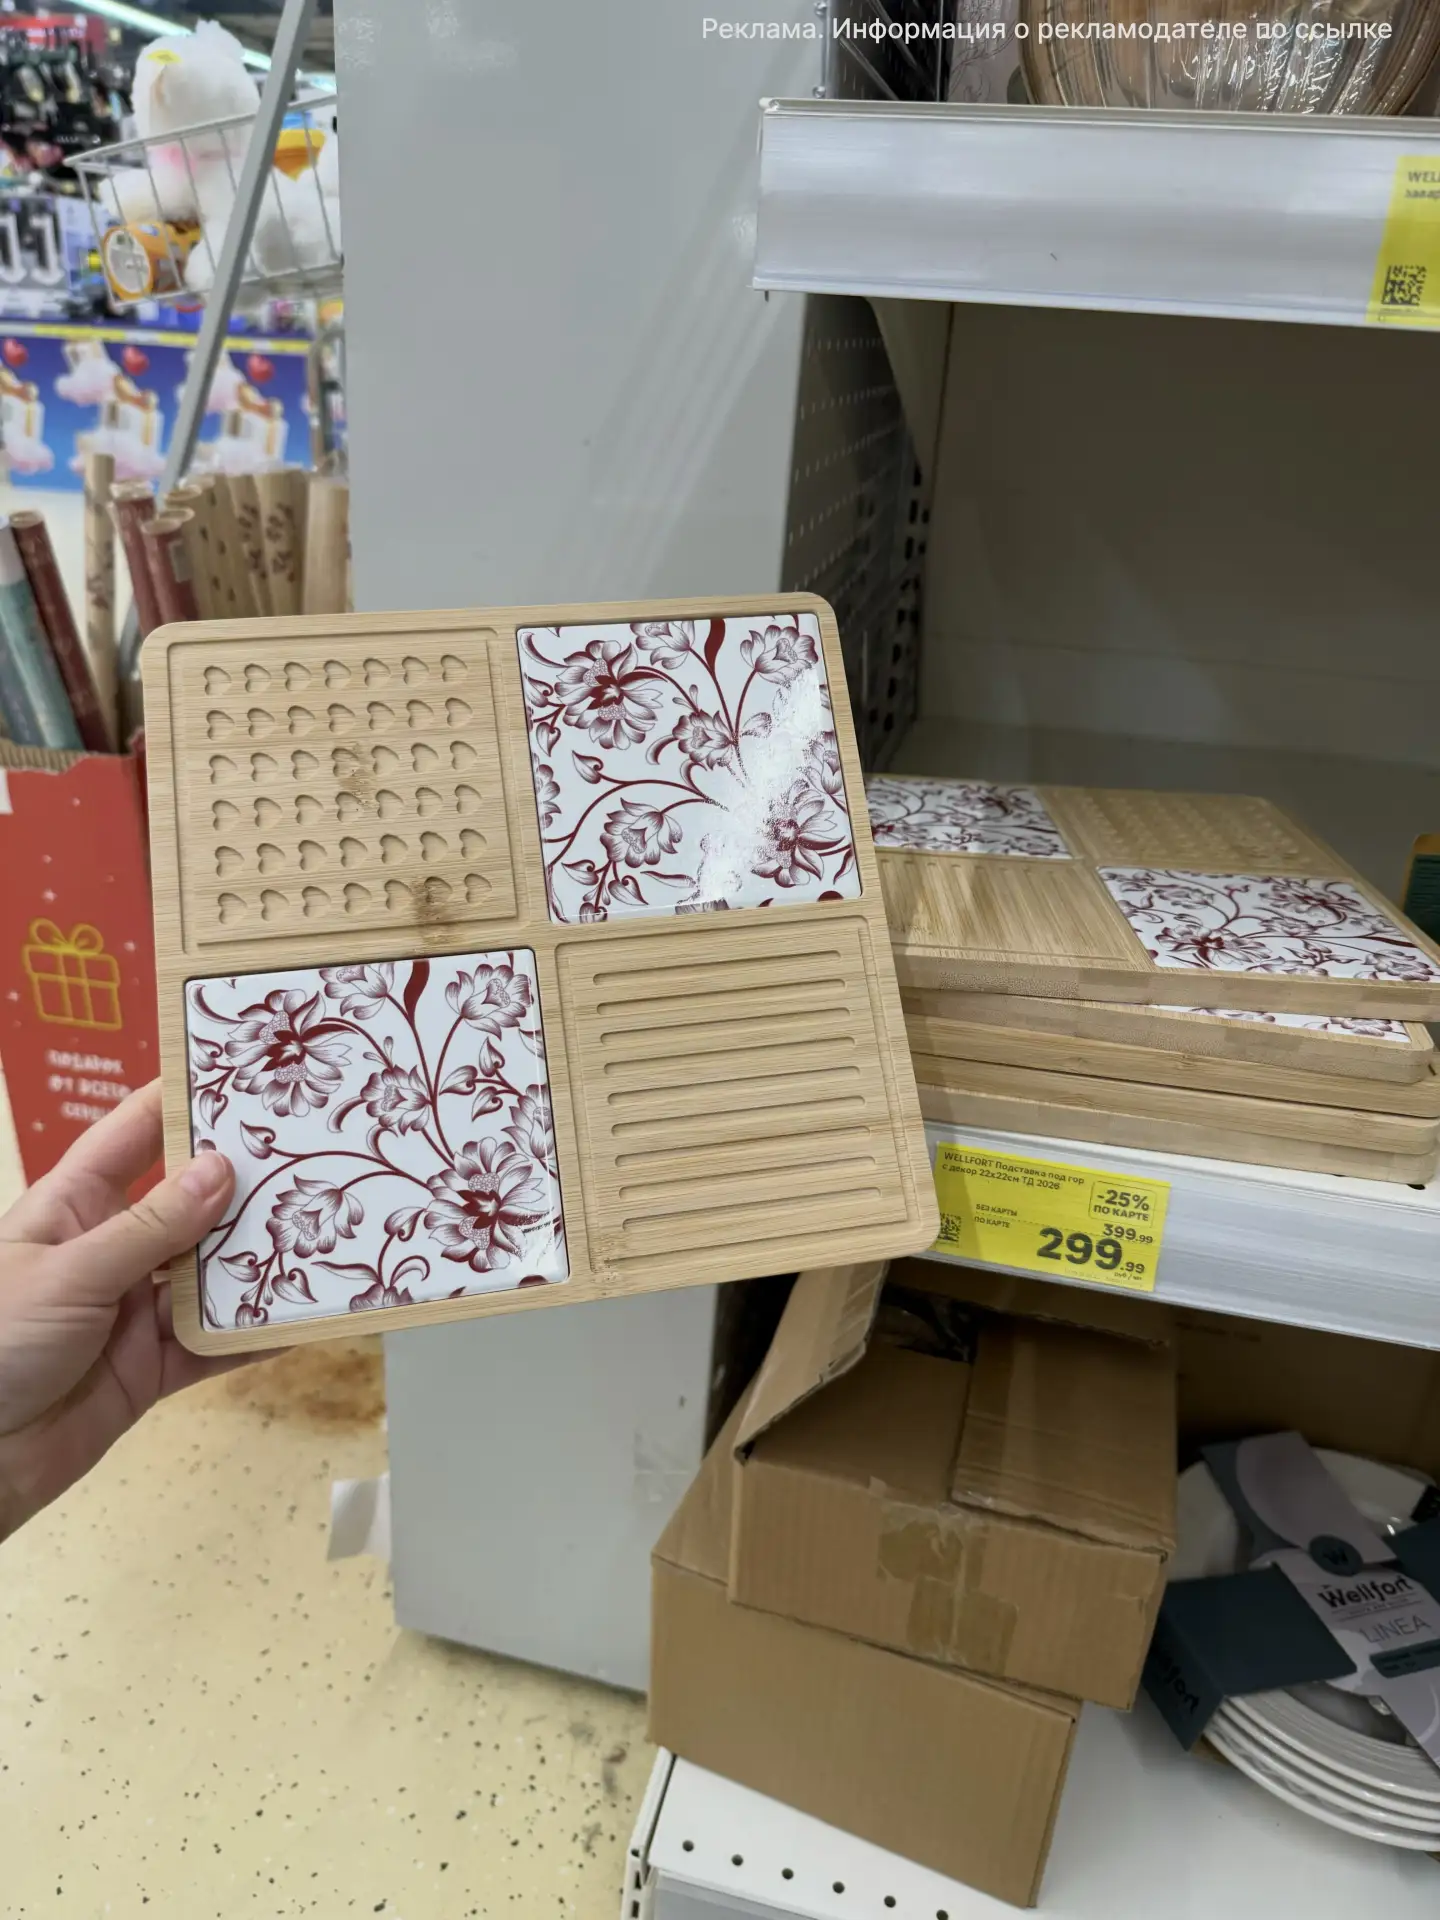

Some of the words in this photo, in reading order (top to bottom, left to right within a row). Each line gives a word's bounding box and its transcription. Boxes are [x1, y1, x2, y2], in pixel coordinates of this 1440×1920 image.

[943, 1151, 994, 1167] WELLFORT
[995, 1161, 1046, 1178] Подставка
[1047, 1172, 1066, 1182] под
[1067, 1175, 1085, 1186] гор
[948, 1165, 977, 1177] декор
[1021, 1176, 1035, 1187] ТД
[1036, 1178, 1061, 1191] 2026
[1094, 1204, 1110, 1215] ПО
[1112, 1208, 1150, 1222] КАРТЕ
[1096, 1189, 1150, 1212] -25%
[986, 1217, 1011, 1229] КАРТЕ
[1316, 1574, 1414, 1608] Wellfort
[1360, 1614, 1432, 1644] LINEA
